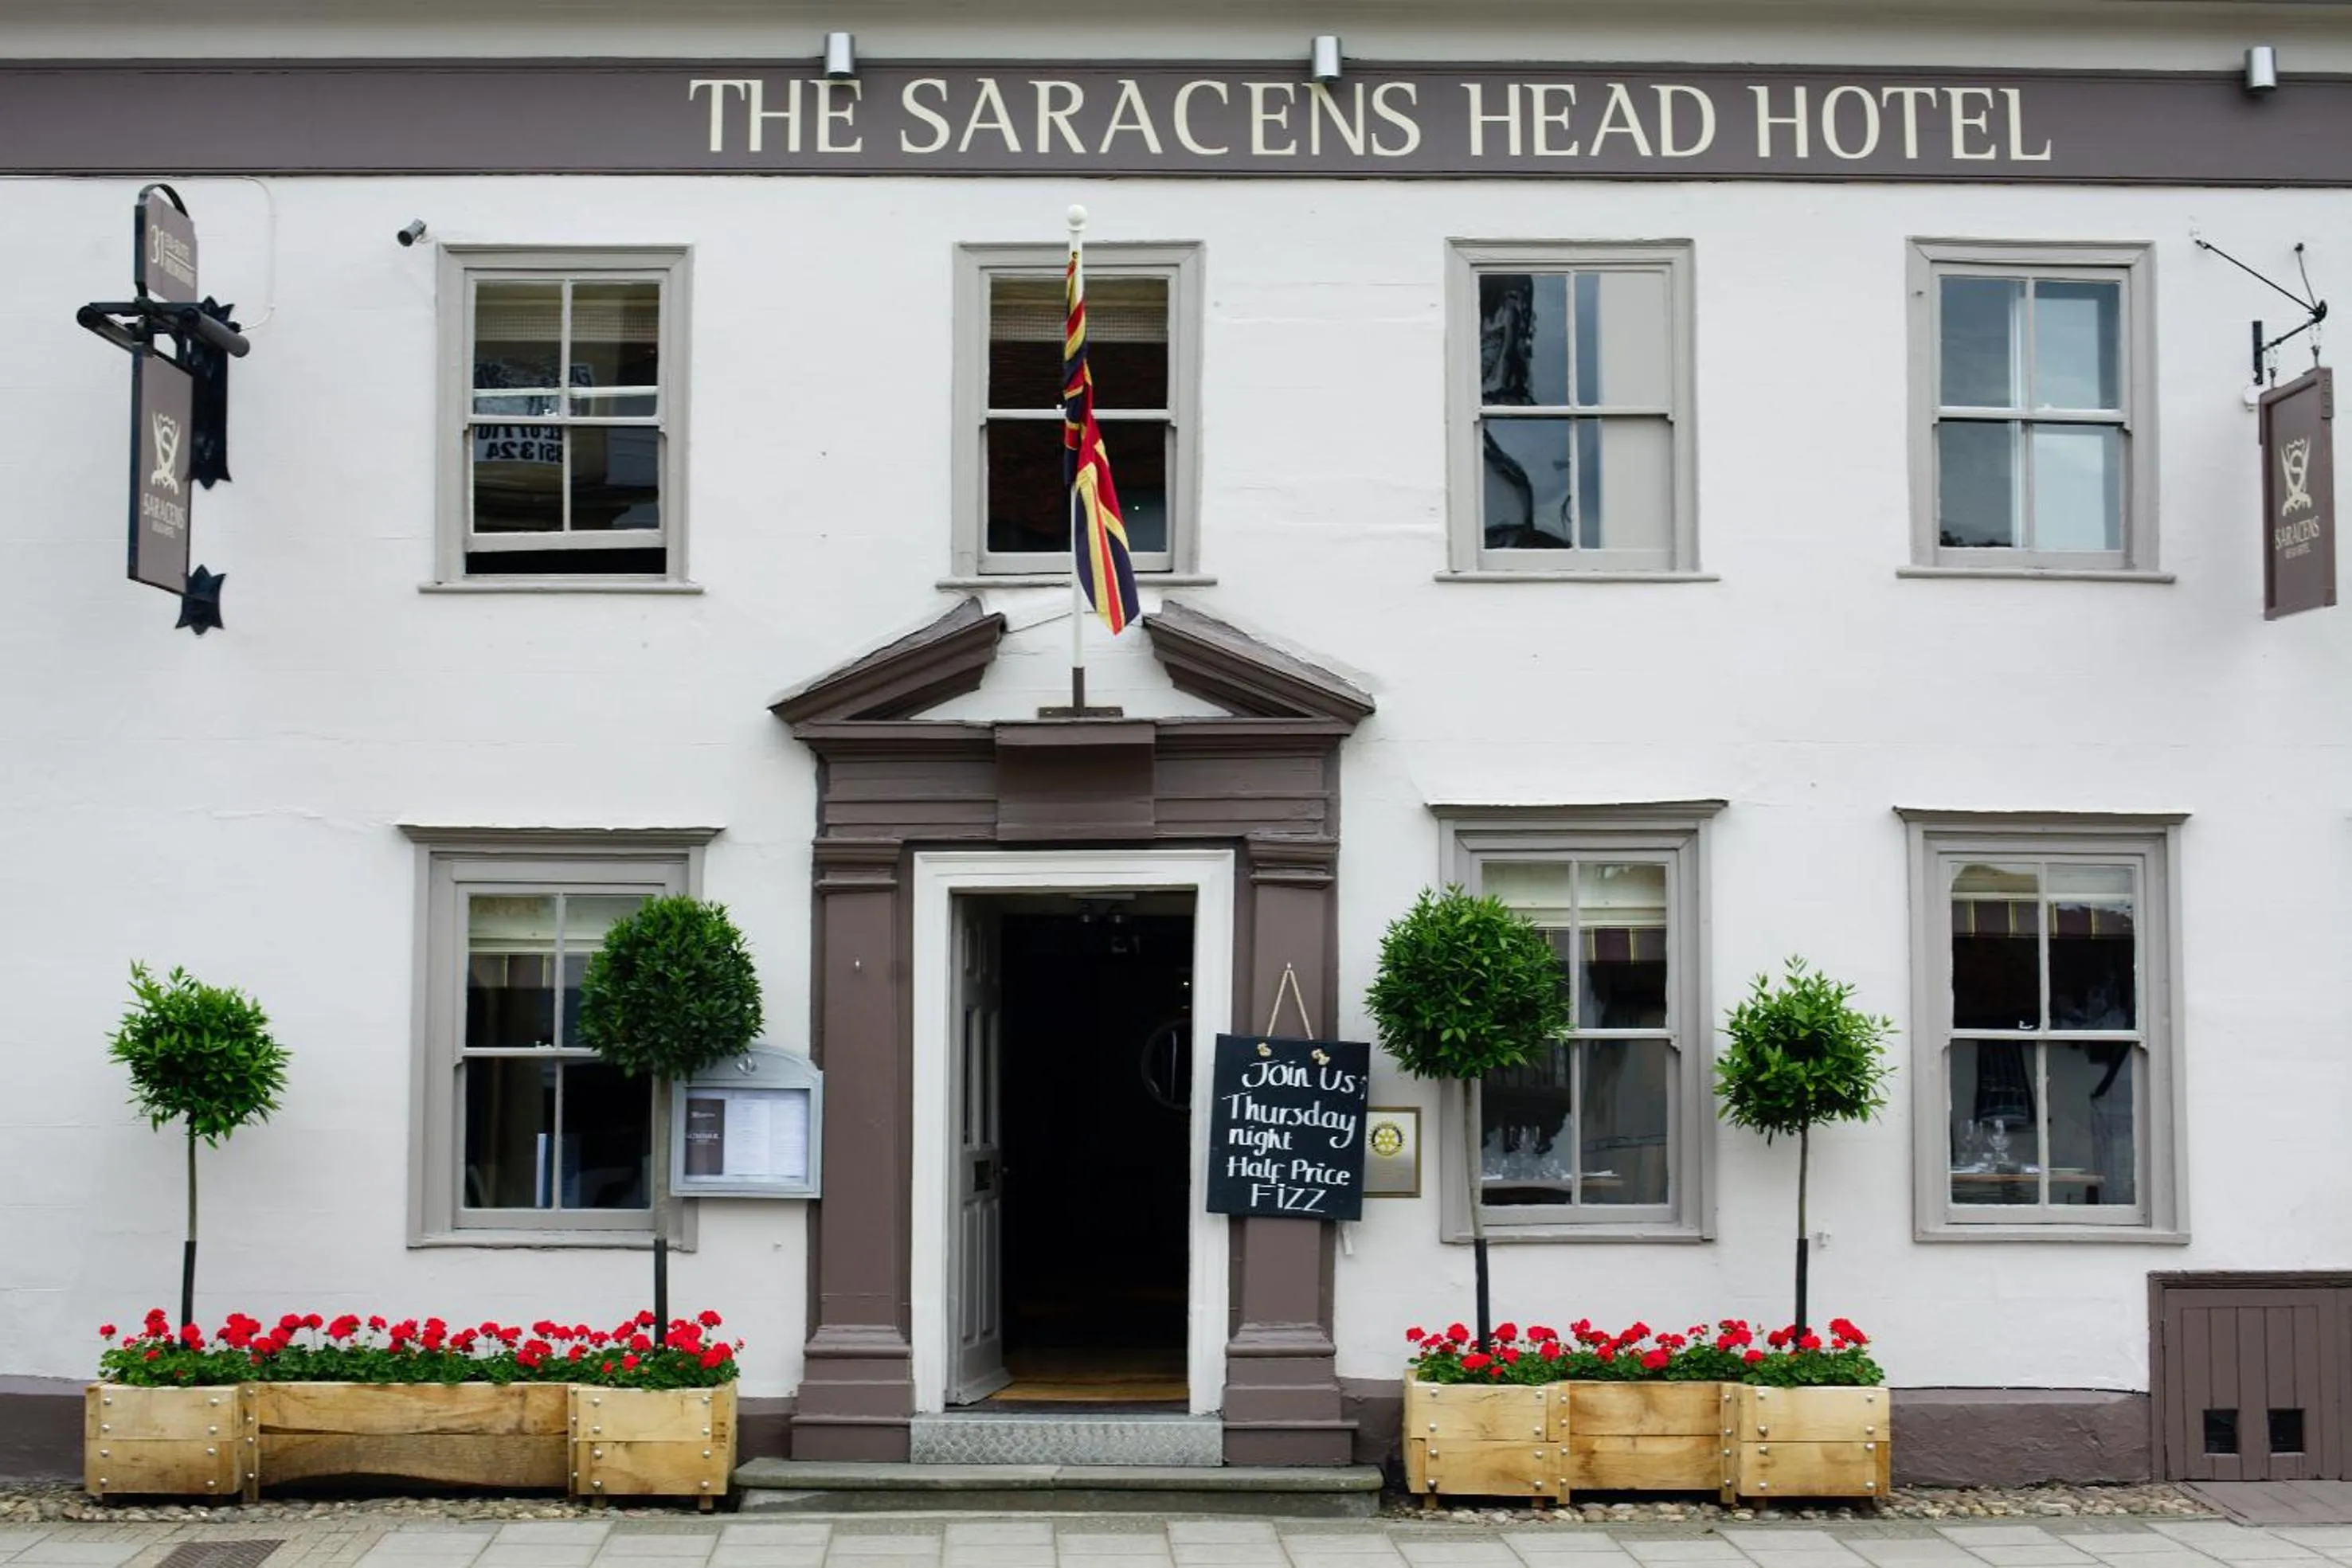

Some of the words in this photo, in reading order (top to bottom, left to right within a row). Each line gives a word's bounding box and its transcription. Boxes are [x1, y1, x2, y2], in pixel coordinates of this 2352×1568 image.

[688, 79, 863, 152] THE
[900, 77, 1421, 156] SARACENS
[1460, 82, 1716, 156] HEAD
[1747, 84, 2052, 160] HOTEL
[150, 224, 164, 267] 31
[2275, 515, 2319, 551] SARACENS
[1241, 1059, 1313, 1088] Join
[1221, 1091, 1356, 1148] Thursday
[1228, 1124, 1293, 1155] night
[1227, 1155, 1286, 1184] Half
[1290, 1159, 1351, 1186] Price
